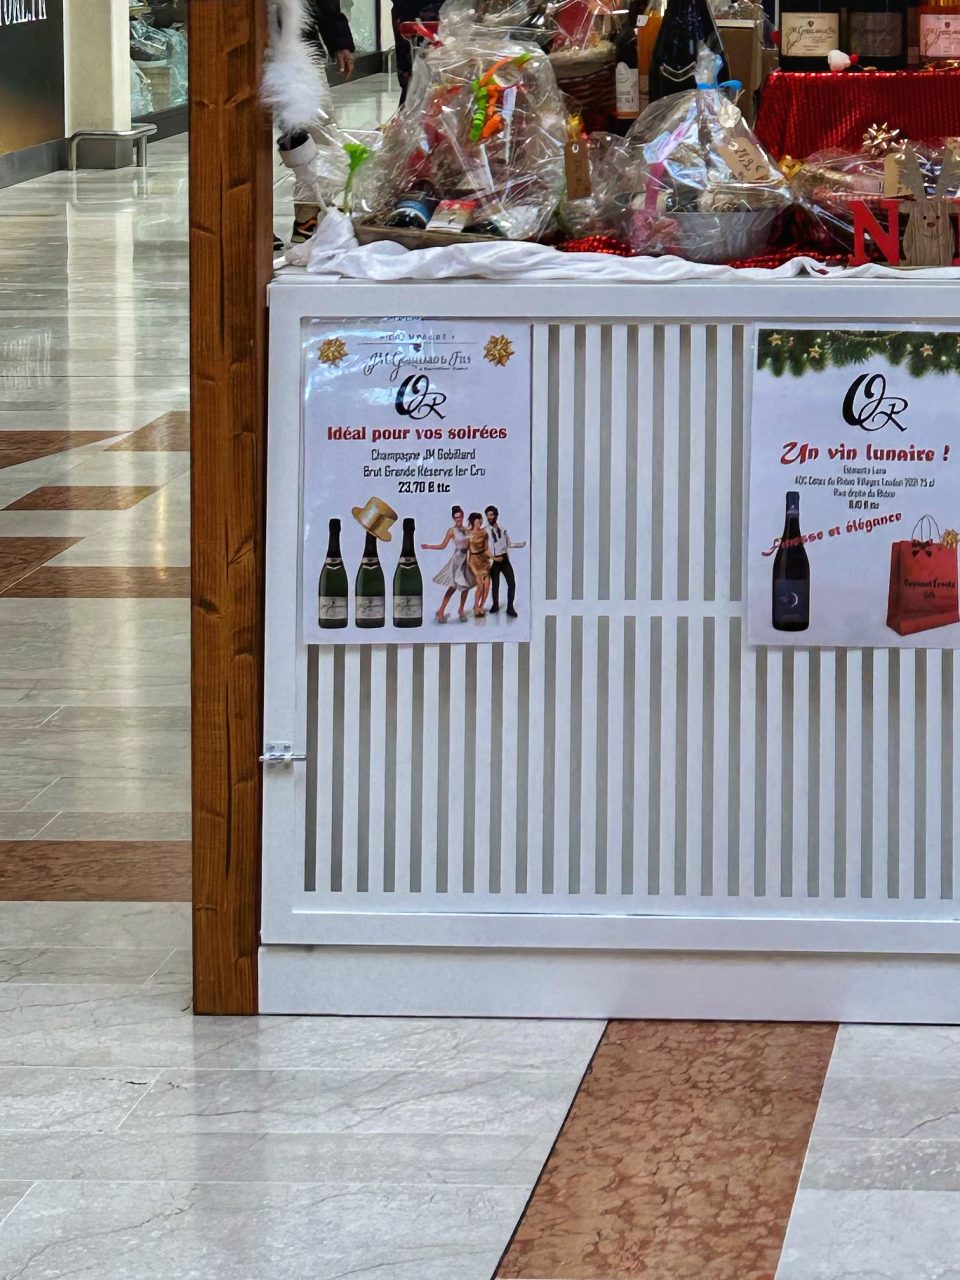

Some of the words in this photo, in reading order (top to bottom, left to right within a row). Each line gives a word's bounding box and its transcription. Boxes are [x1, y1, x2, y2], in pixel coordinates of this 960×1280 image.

[327, 426, 366, 440] Idéal
[372, 429, 411, 443] pour
[415, 429, 443, 440] vos
[448, 425, 508, 440] soirées
[371, 448, 421, 462] Champagne
[780, 441, 819, 465] Un
[828, 443, 858, 461] vin
[866, 443, 936, 462] lunaire
[942, 444, 950, 462] !
[363, 465, 382, 477] Brut
[385, 465, 416, 477] Grande
[417, 464, 453, 477] Réserve
[470, 464, 486, 476] Cru
[828, 526, 842, 538] et
[846, 512, 903, 533] élégance
